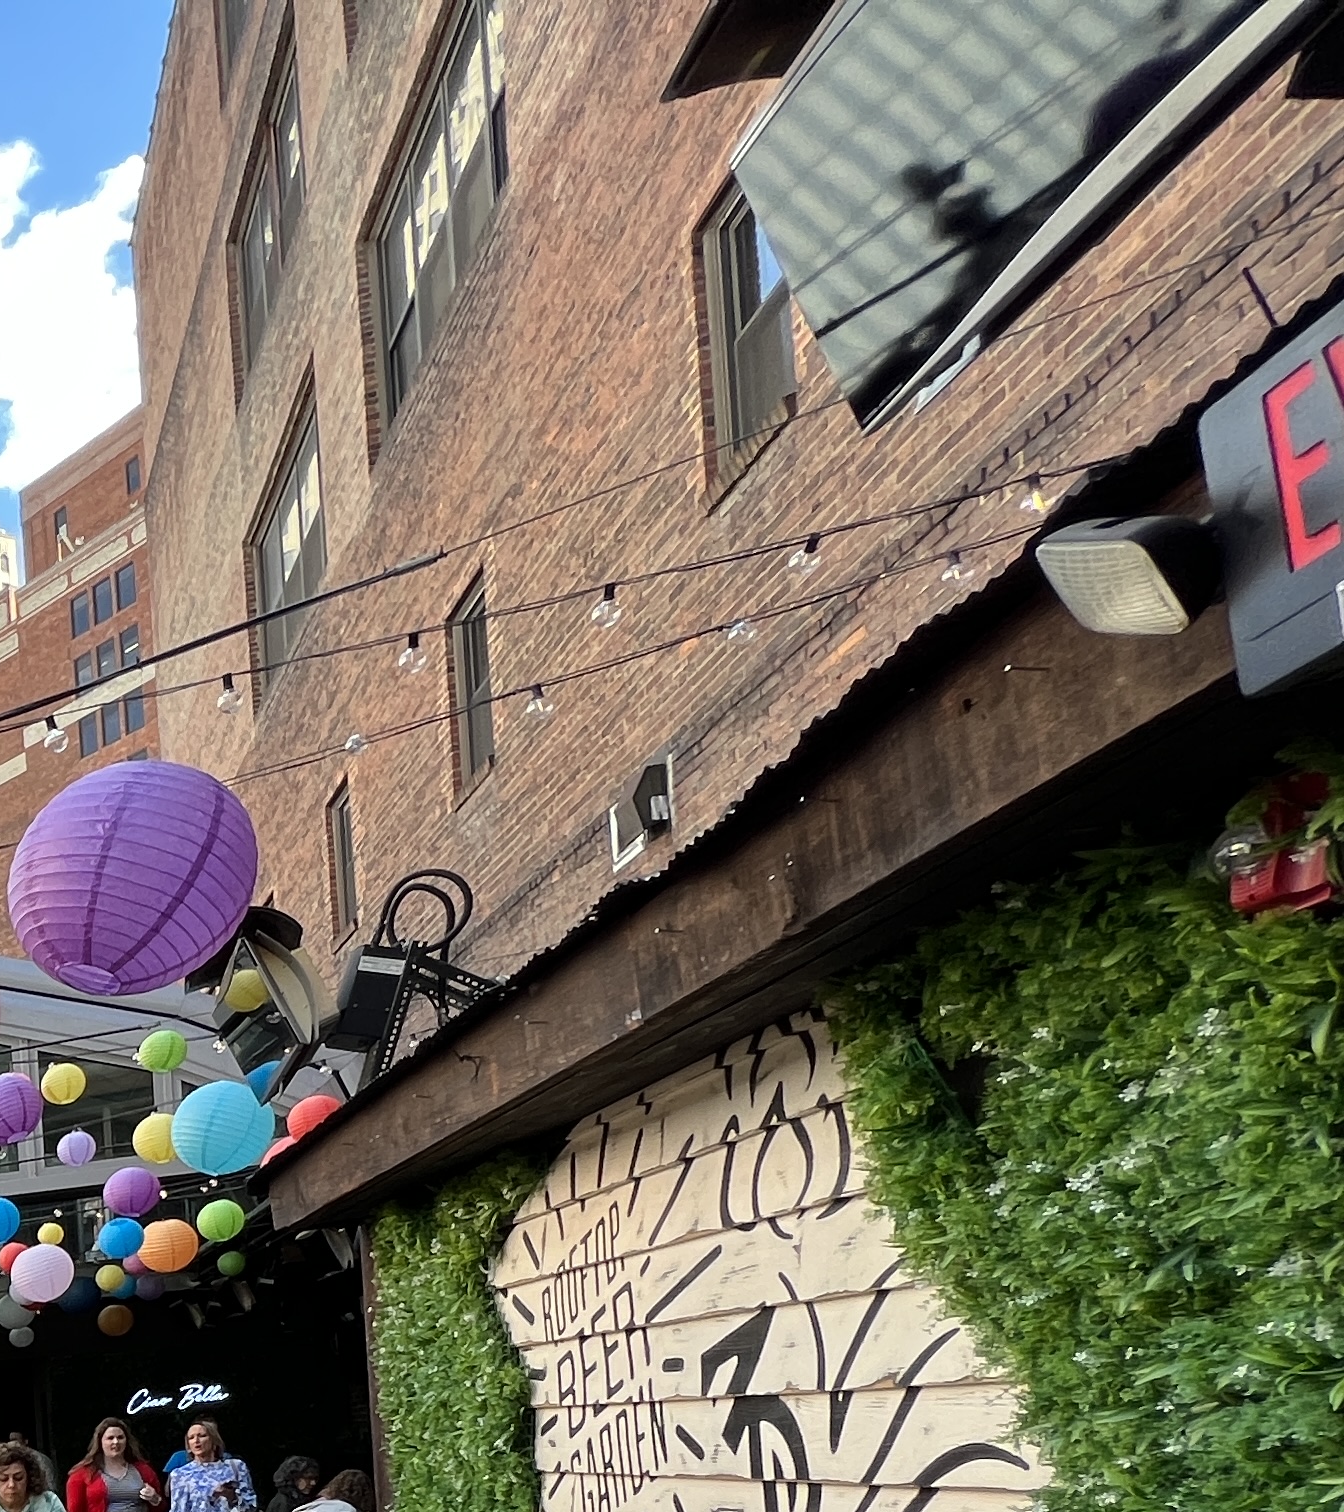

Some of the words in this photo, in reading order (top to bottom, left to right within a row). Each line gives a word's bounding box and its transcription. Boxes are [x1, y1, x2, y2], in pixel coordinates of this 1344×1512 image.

[1262, 334, 1344, 573] E
[542, 1200, 625, 1347] ROOFTOP
[126, 1388, 173, 1415] Ciao
[177, 1383, 230, 1410] Bella
[557, 1281, 651, 1439] BEER
